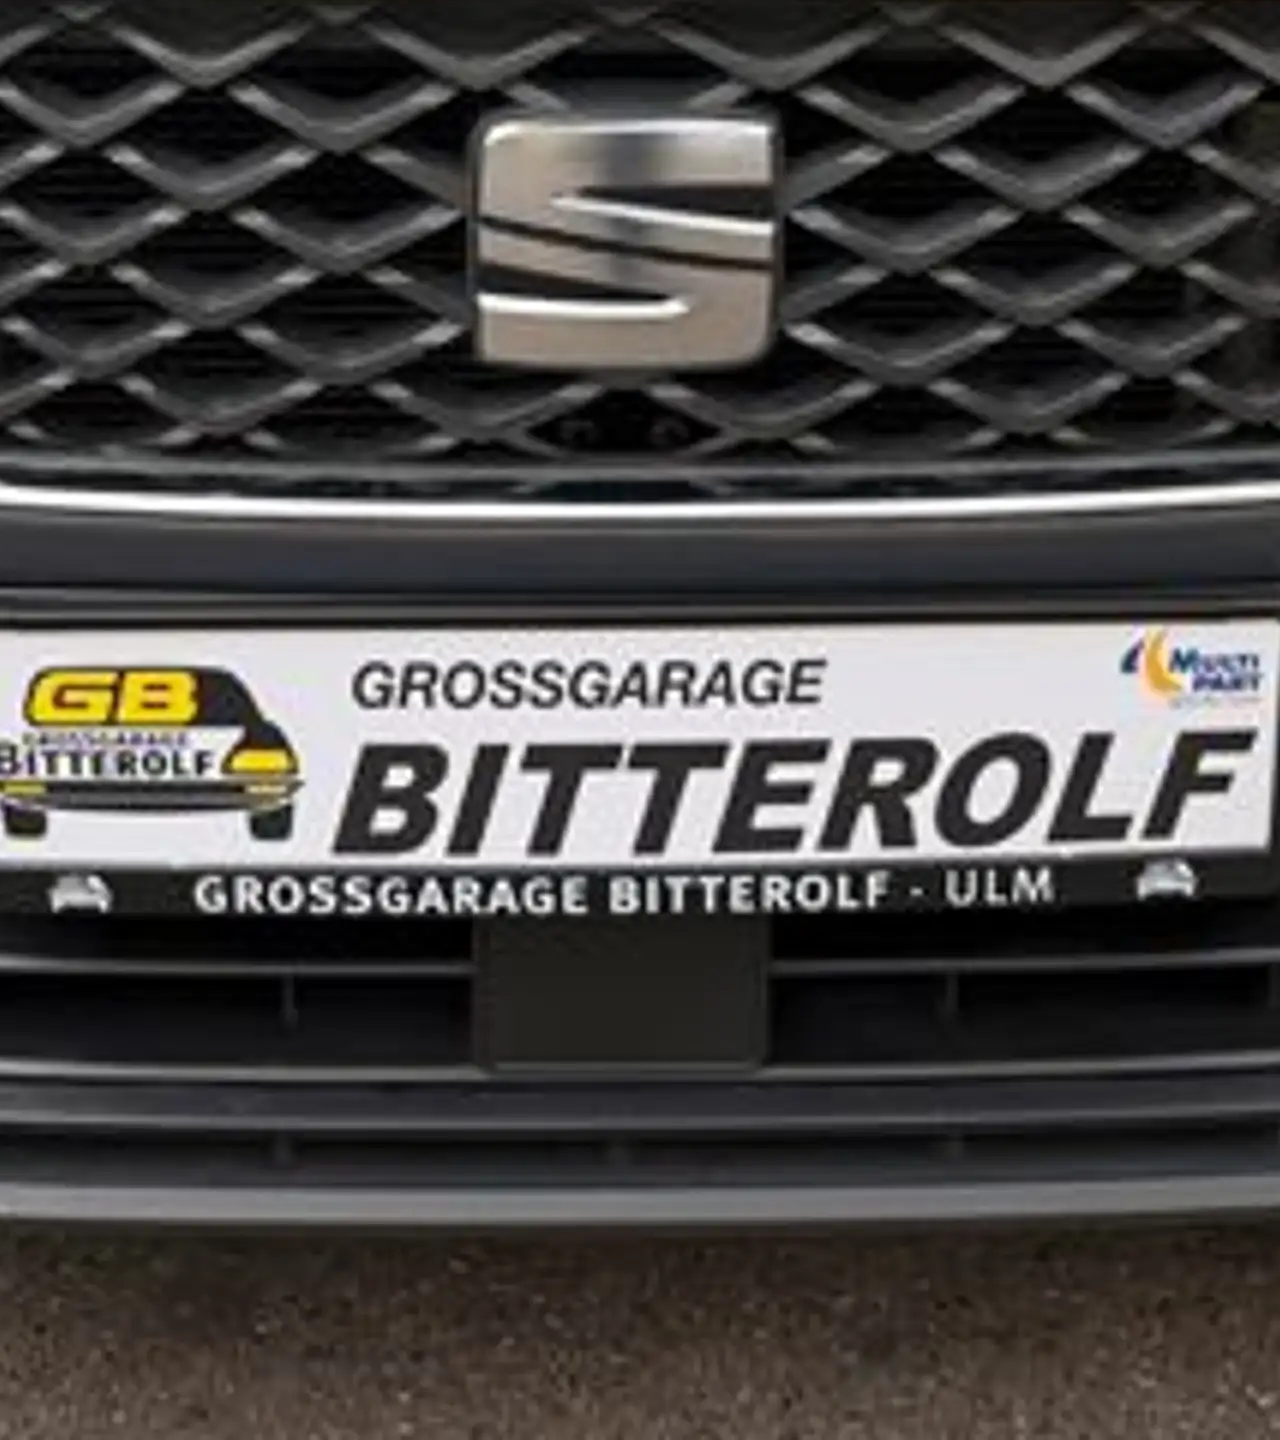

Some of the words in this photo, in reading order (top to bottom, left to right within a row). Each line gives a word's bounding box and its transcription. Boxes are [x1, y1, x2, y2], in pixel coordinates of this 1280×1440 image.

[29, 669, 199, 724] GB
[351, 657, 828, 710] GROSSGARAGE
[331, 728, 1260, 859] BITTEROLF
[193, 874, 590, 917] GROSSGARAGE
[610, 871, 891, 914] BITTEROLF
[944, 866, 1056, 908] ULM
